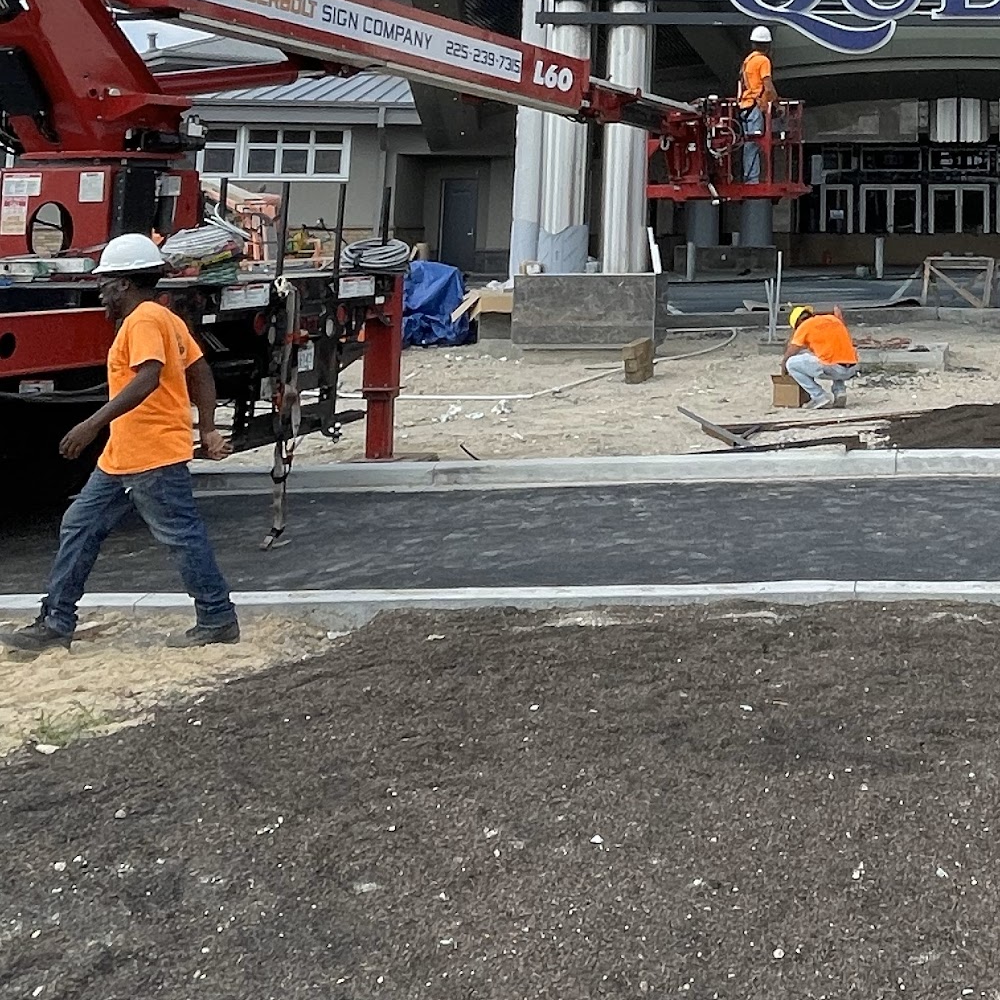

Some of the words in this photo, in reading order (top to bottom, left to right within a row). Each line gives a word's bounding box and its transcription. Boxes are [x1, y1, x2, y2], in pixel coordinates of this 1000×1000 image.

[322, 4, 359, 30] SIGN
[363, 16, 433, 50] COMPANY
[446, 40, 521, 74] 225-239-7315
[533, 59, 574, 92] L60
